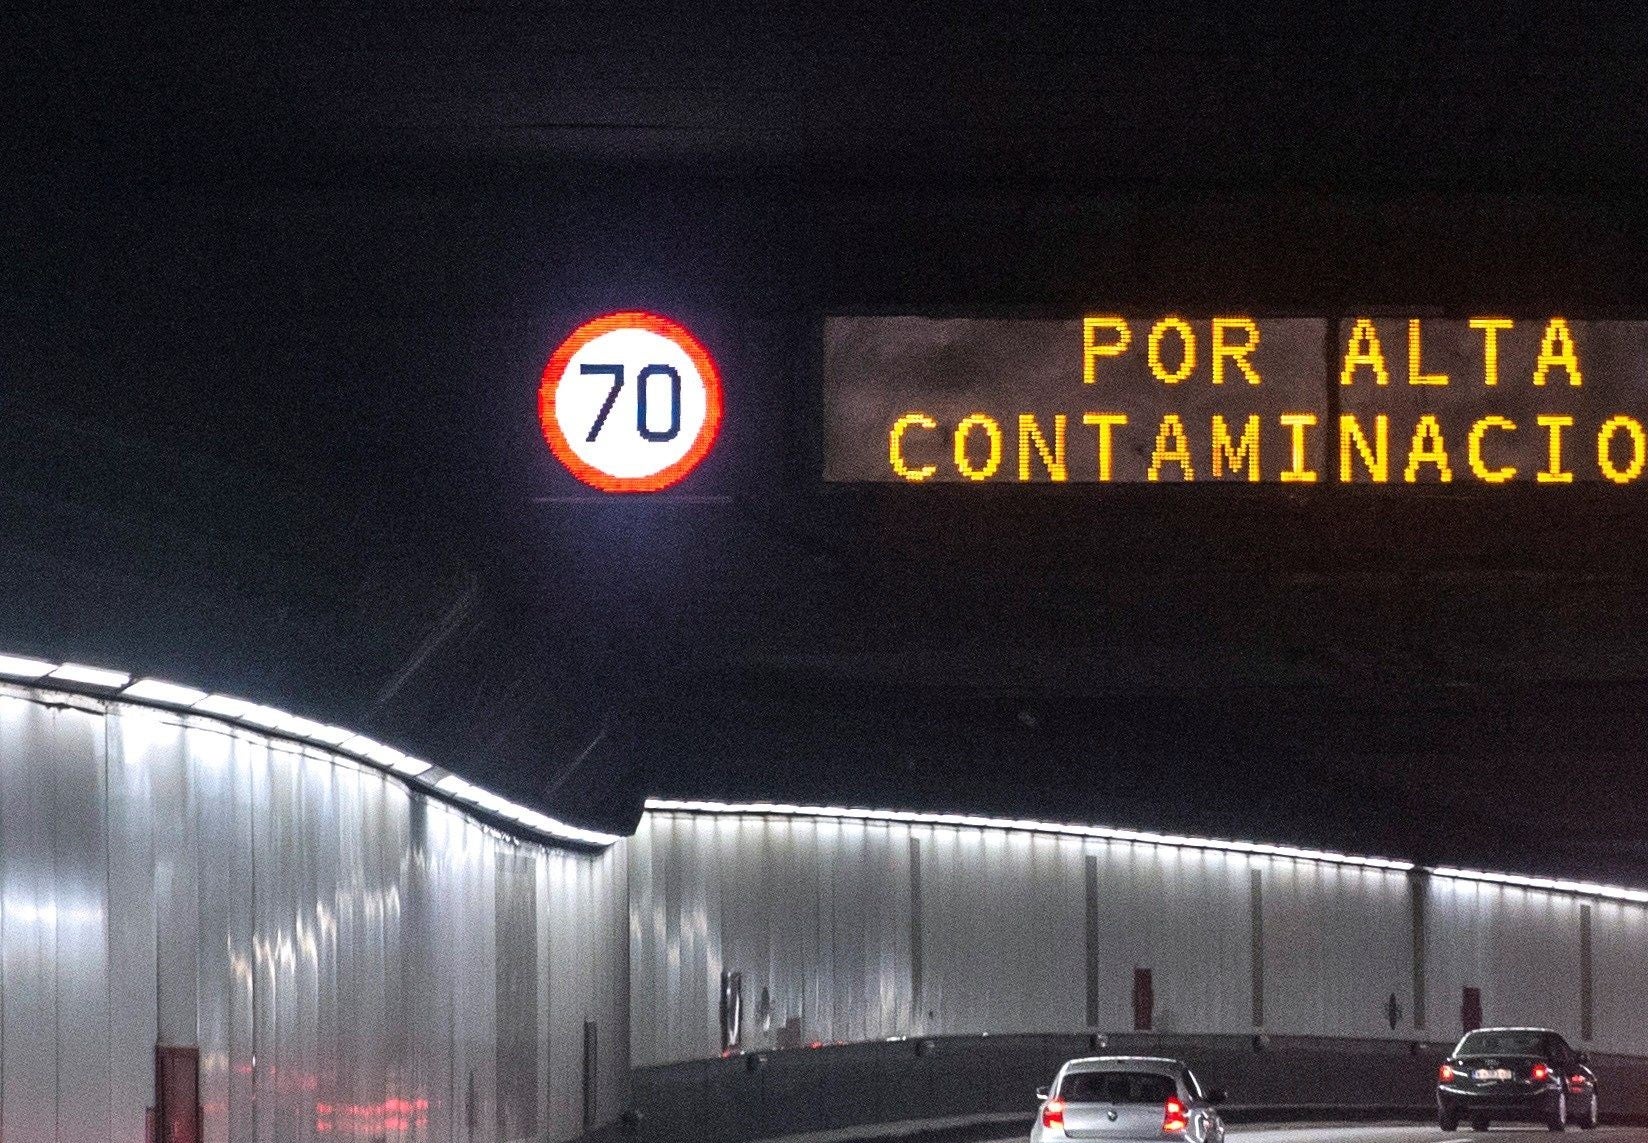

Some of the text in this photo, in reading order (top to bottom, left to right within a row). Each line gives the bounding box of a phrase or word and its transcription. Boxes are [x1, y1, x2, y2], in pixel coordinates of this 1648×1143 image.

[1081, 316, 1583, 386] POR ALTA
[579, 362, 682, 443] 70
